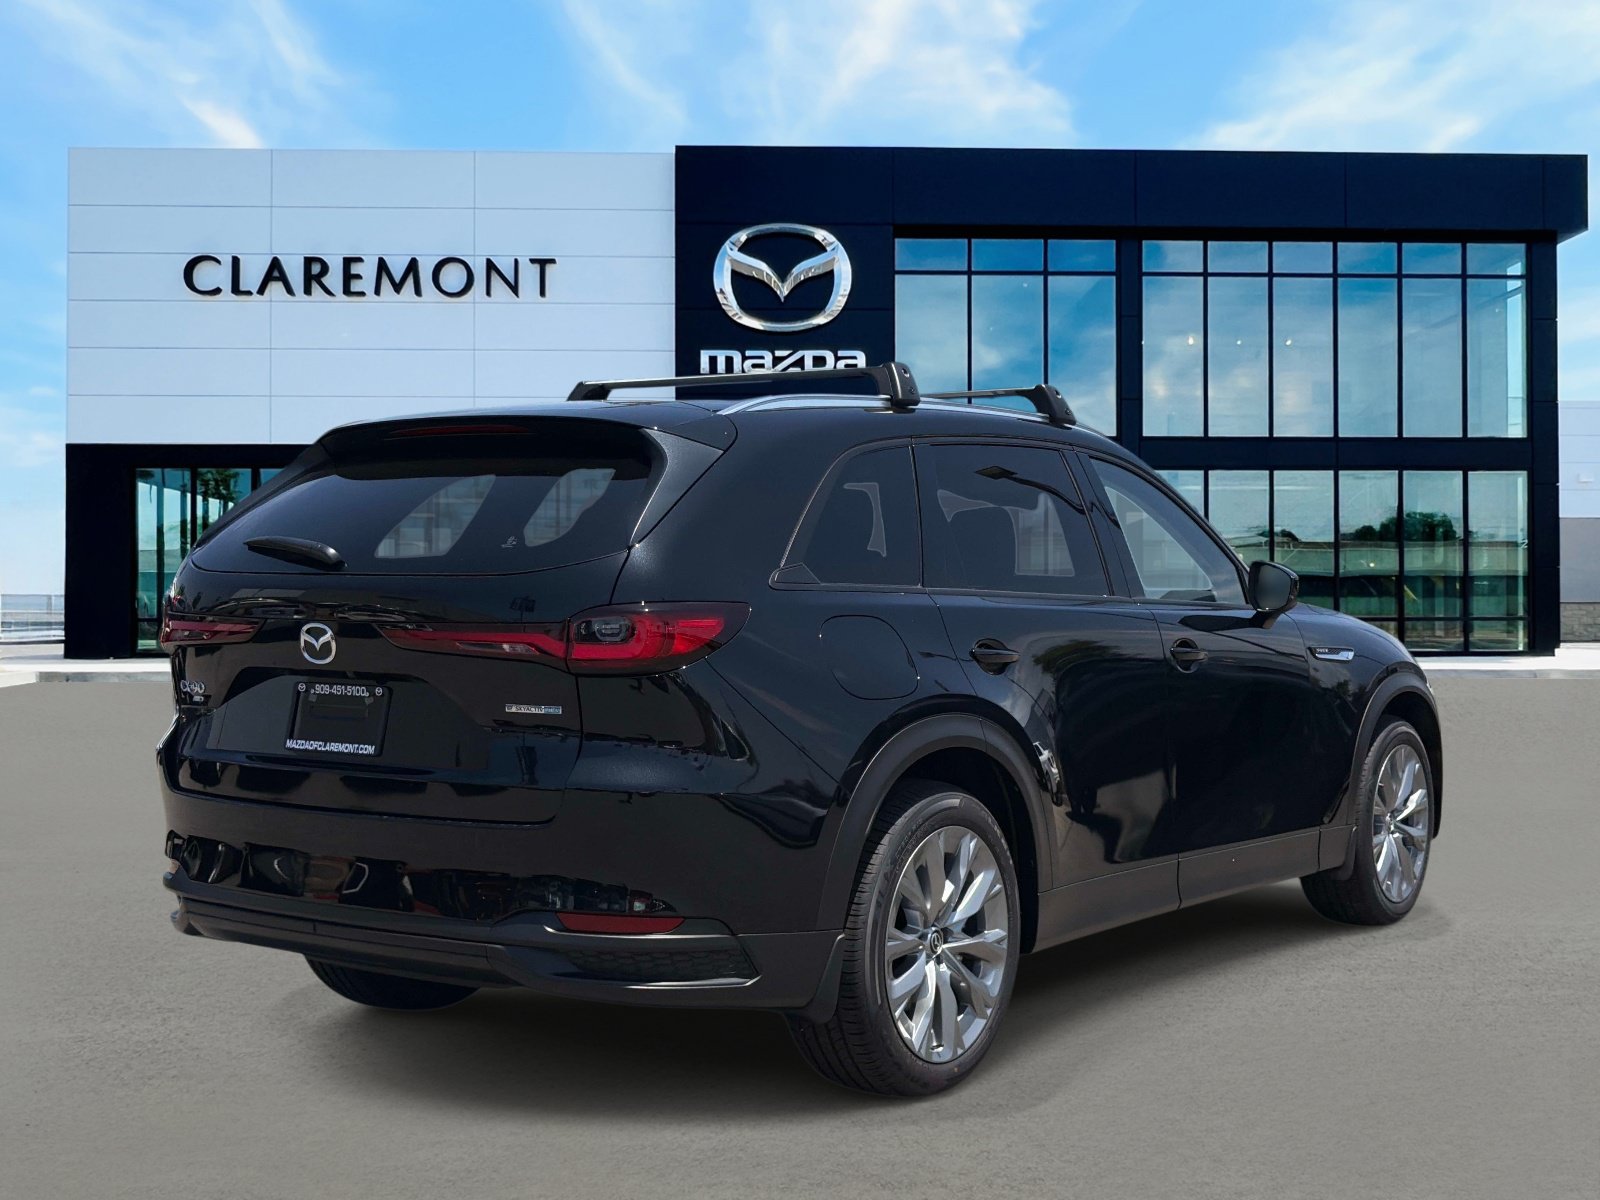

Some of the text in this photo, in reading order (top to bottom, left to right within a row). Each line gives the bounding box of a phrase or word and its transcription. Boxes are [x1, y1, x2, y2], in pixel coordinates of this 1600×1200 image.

[183, 254, 557, 298] CLAREMONT
[315, 684, 366, 697] 909-451-5100
[515, 705, 544, 713] SKYACTIV
[285, 739, 375, 755] MAZDAOFCLAREMONT.COM
